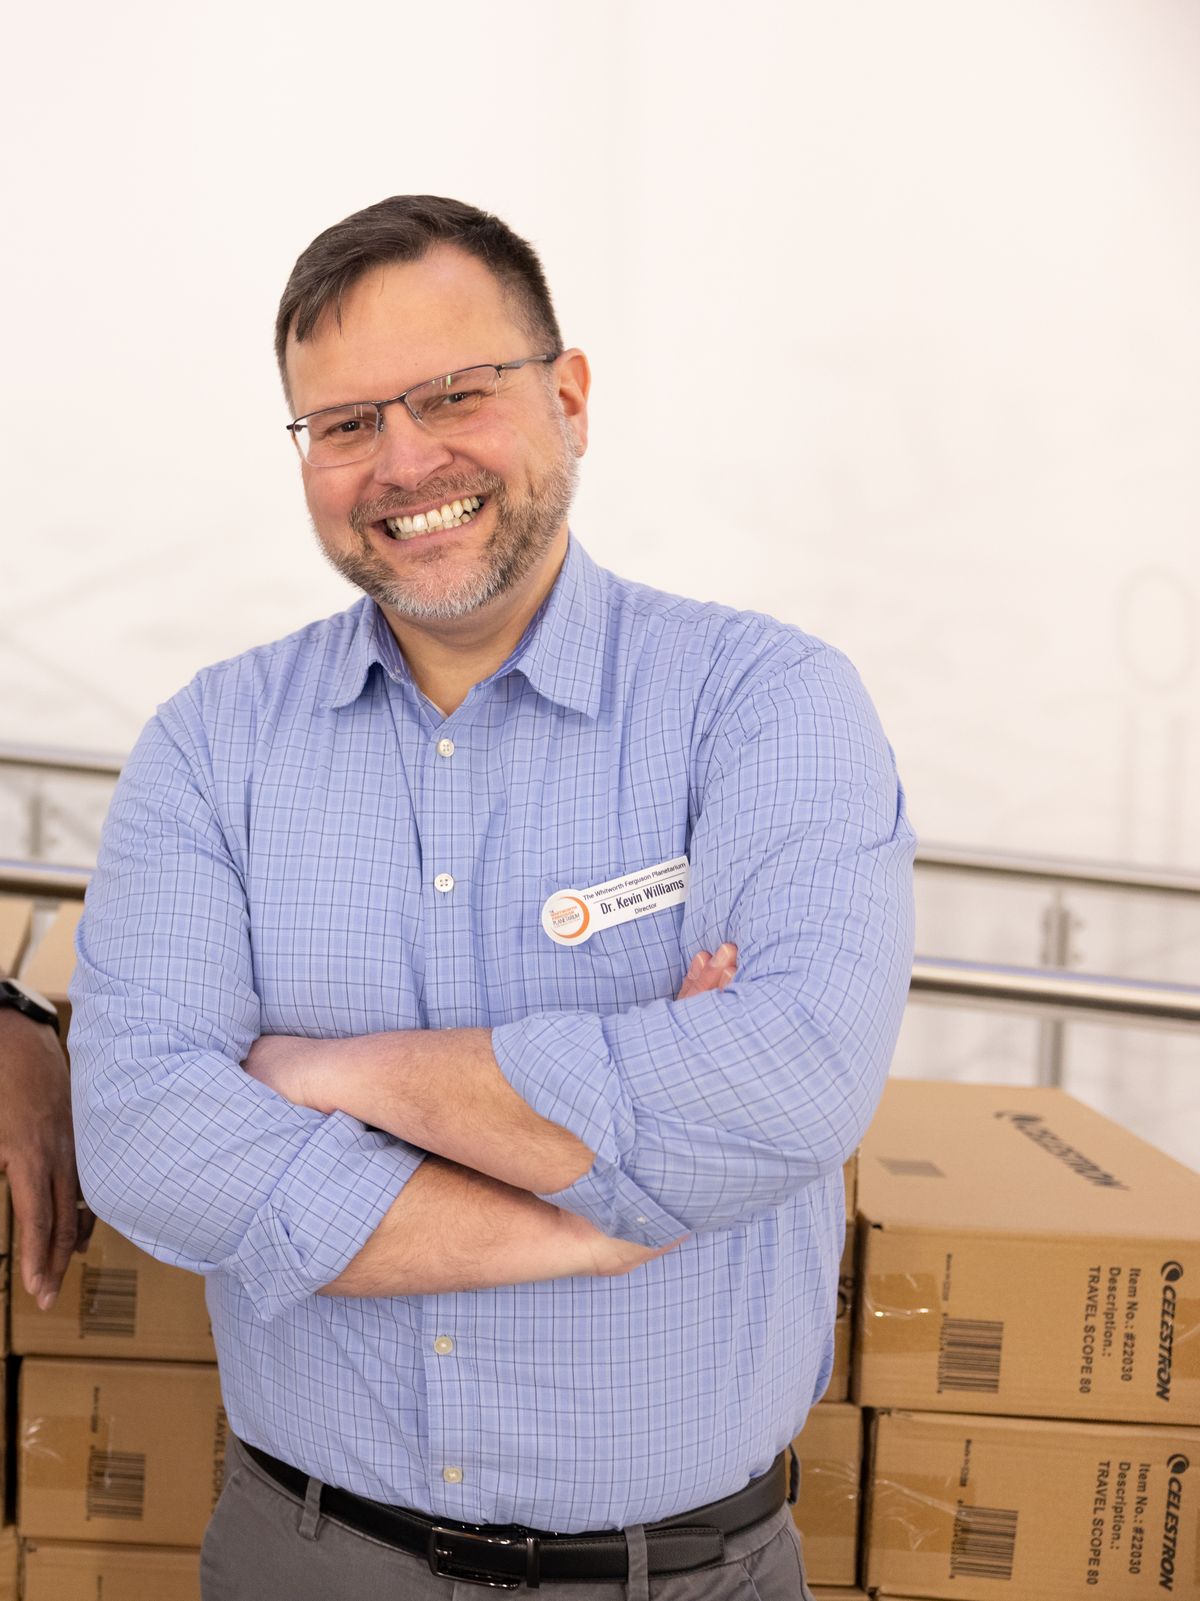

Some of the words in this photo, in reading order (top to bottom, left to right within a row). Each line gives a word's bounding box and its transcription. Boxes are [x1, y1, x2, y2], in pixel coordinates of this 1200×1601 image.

[595, 883, 624, 898] Whitworth
[624, 874, 651, 889] Ferguson
[650, 862, 686, 880] Planetarium
[600, 902, 616, 915] Dr.
[616, 893, 643, 911] Kevin
[643, 879, 685, 899] Williams
[634, 902, 657, 914] Director
[1084, 1265, 1101, 1321] TRAVEL
[1129, 1268, 1142, 1298] Item
[1102, 1266, 1121, 1357] Description.:
[1125, 1301, 1138, 1329] No.:
[1080, 1325, 1095, 1375] SCOPE
[1121, 1332, 1135, 1382] #22030
[1156, 1284, 1176, 1402] CELESTRON
[1079, 1378, 1091, 1394] 80
[1093, 1460, 1111, 1514] TRAVEL
[1137, 1463, 1151, 1492] Item
[1110, 1461, 1131, 1550] Description.:
[1134, 1496, 1148, 1524] No.:
[1088, 1518, 1104, 1566] SCOPE
[1128, 1527, 1144, 1575] #22030
[1159, 1477, 1182, 1592] CELESTRON
[1086, 1569, 1099, 1585] 80
